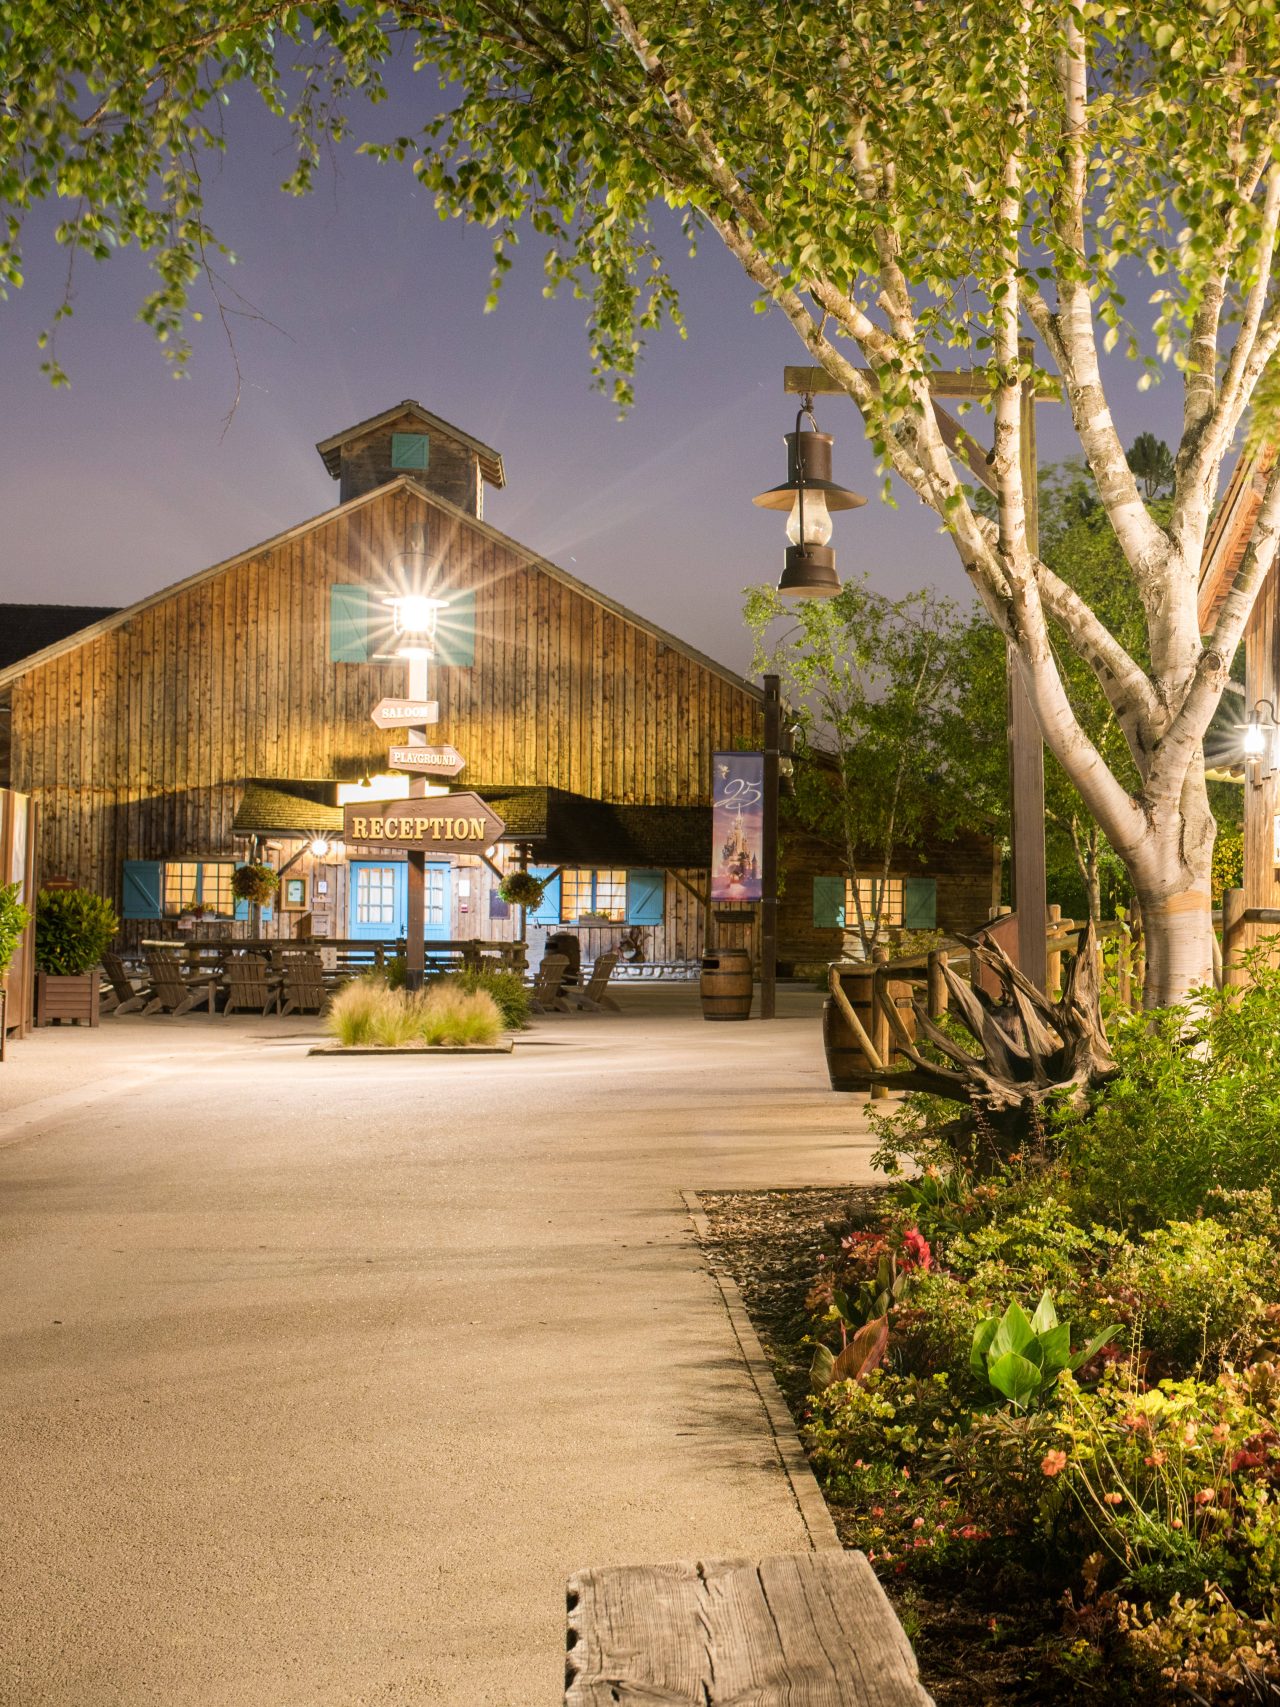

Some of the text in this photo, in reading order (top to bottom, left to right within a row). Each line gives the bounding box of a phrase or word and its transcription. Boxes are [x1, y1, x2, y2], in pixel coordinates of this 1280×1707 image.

[381, 706, 429, 719] SALOON
[393, 751, 456, 766] PLAYGROUND
[713, 778, 762, 810] 25
[352, 817, 486, 841] RECEPTION
